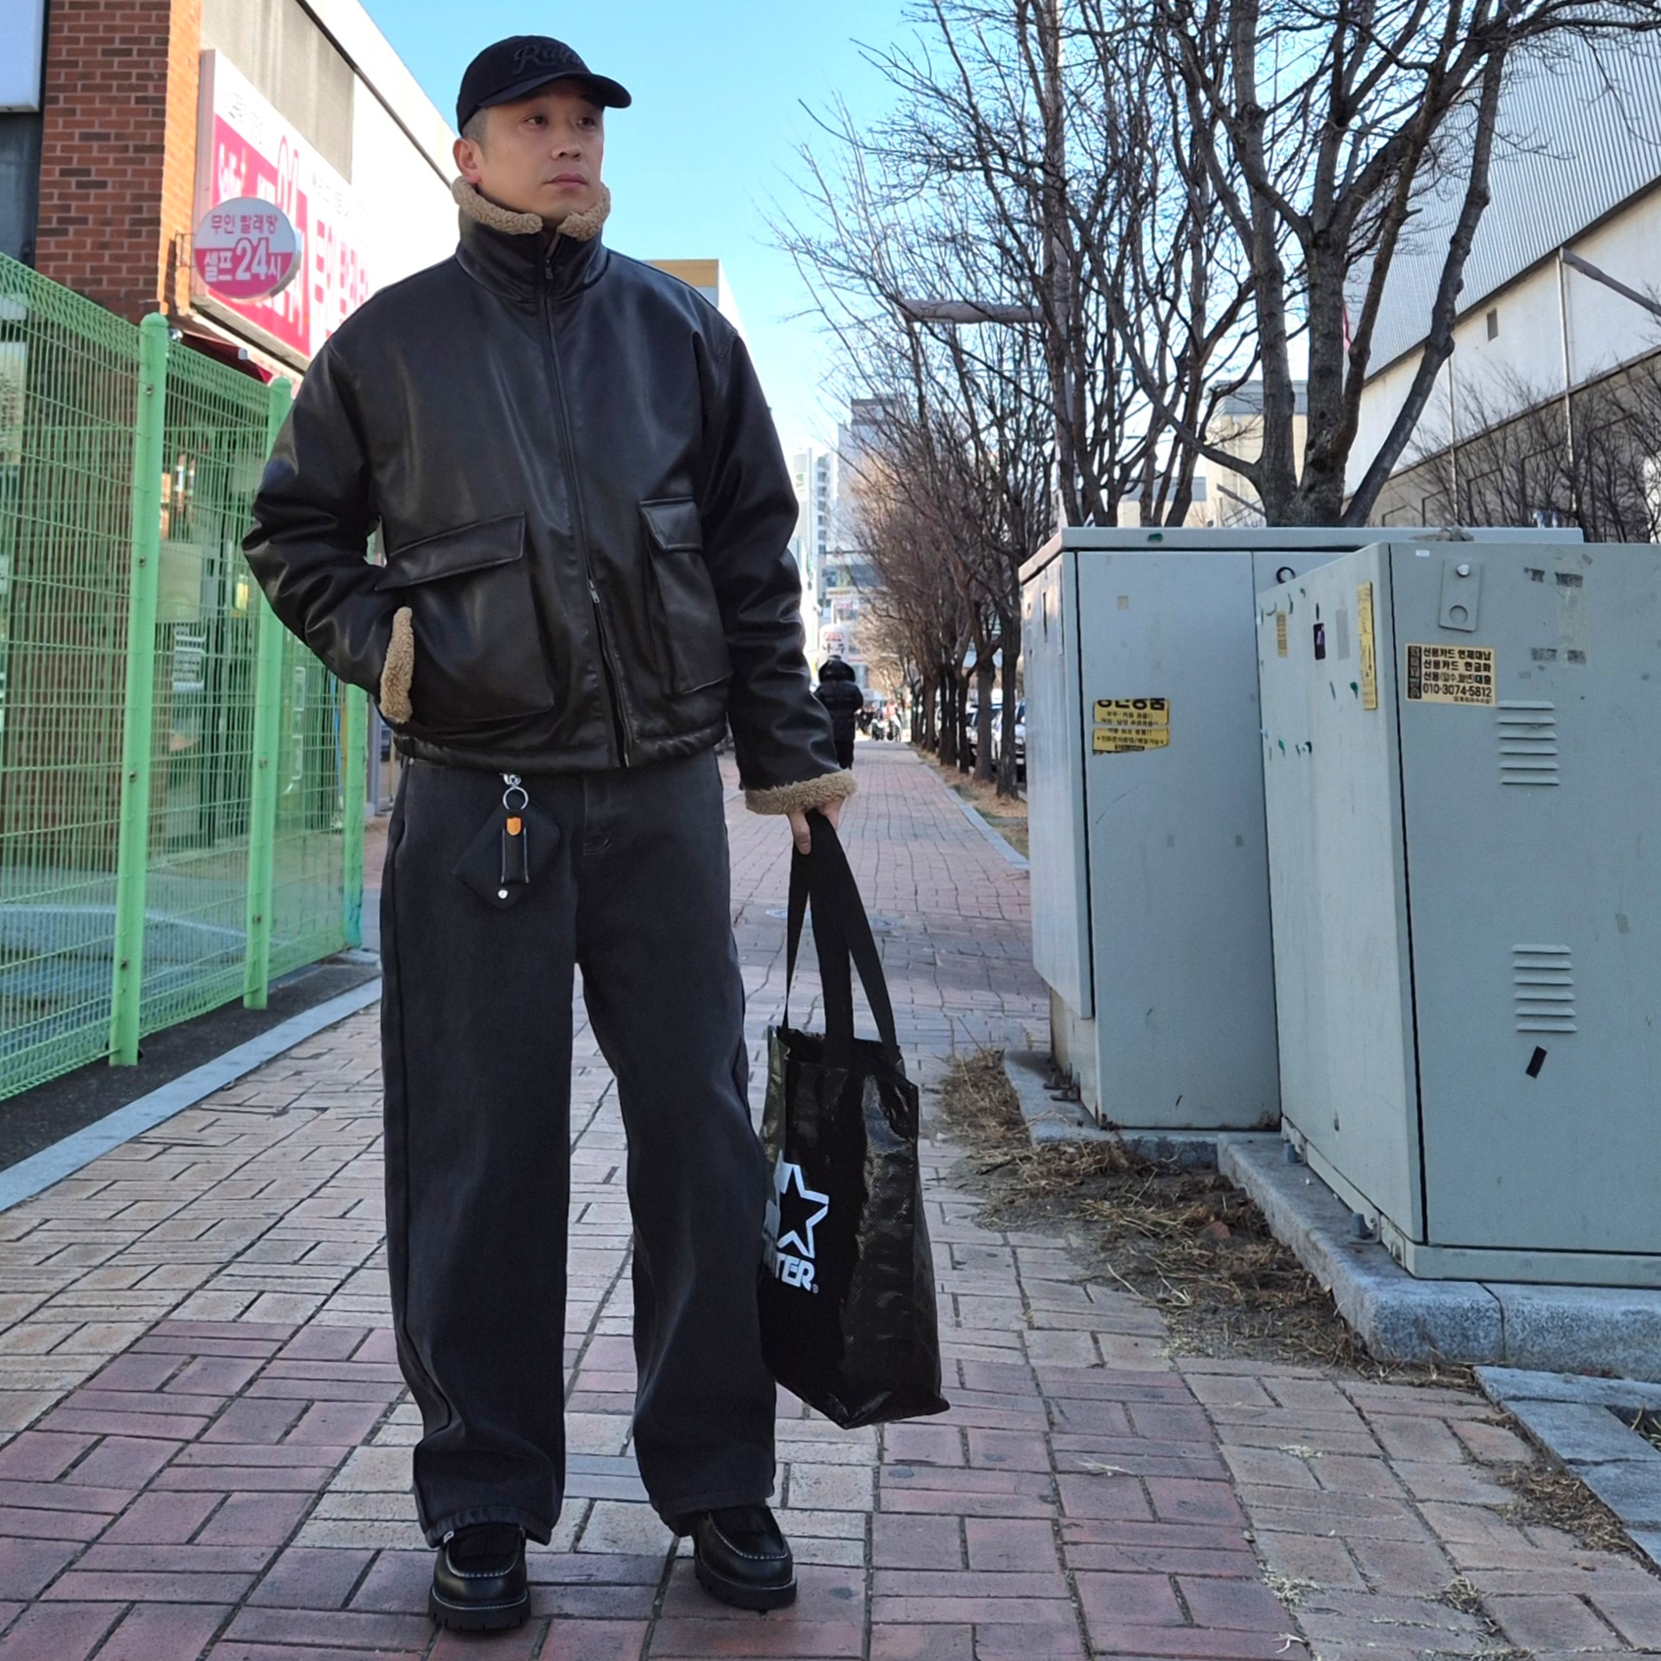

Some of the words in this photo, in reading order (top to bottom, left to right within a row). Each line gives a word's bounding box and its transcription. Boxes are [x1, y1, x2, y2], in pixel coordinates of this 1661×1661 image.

[211, 214, 236, 235] 무인
[240, 214, 278, 235] 빨래방
[204, 251, 233, 282] 셀프
[235, 237, 282, 281] 24시
[1424, 647, 1456, 659] 신용카드
[1424, 660, 1460, 671] 신용카드
[1423, 684, 1491, 697] 010-3074-5812
